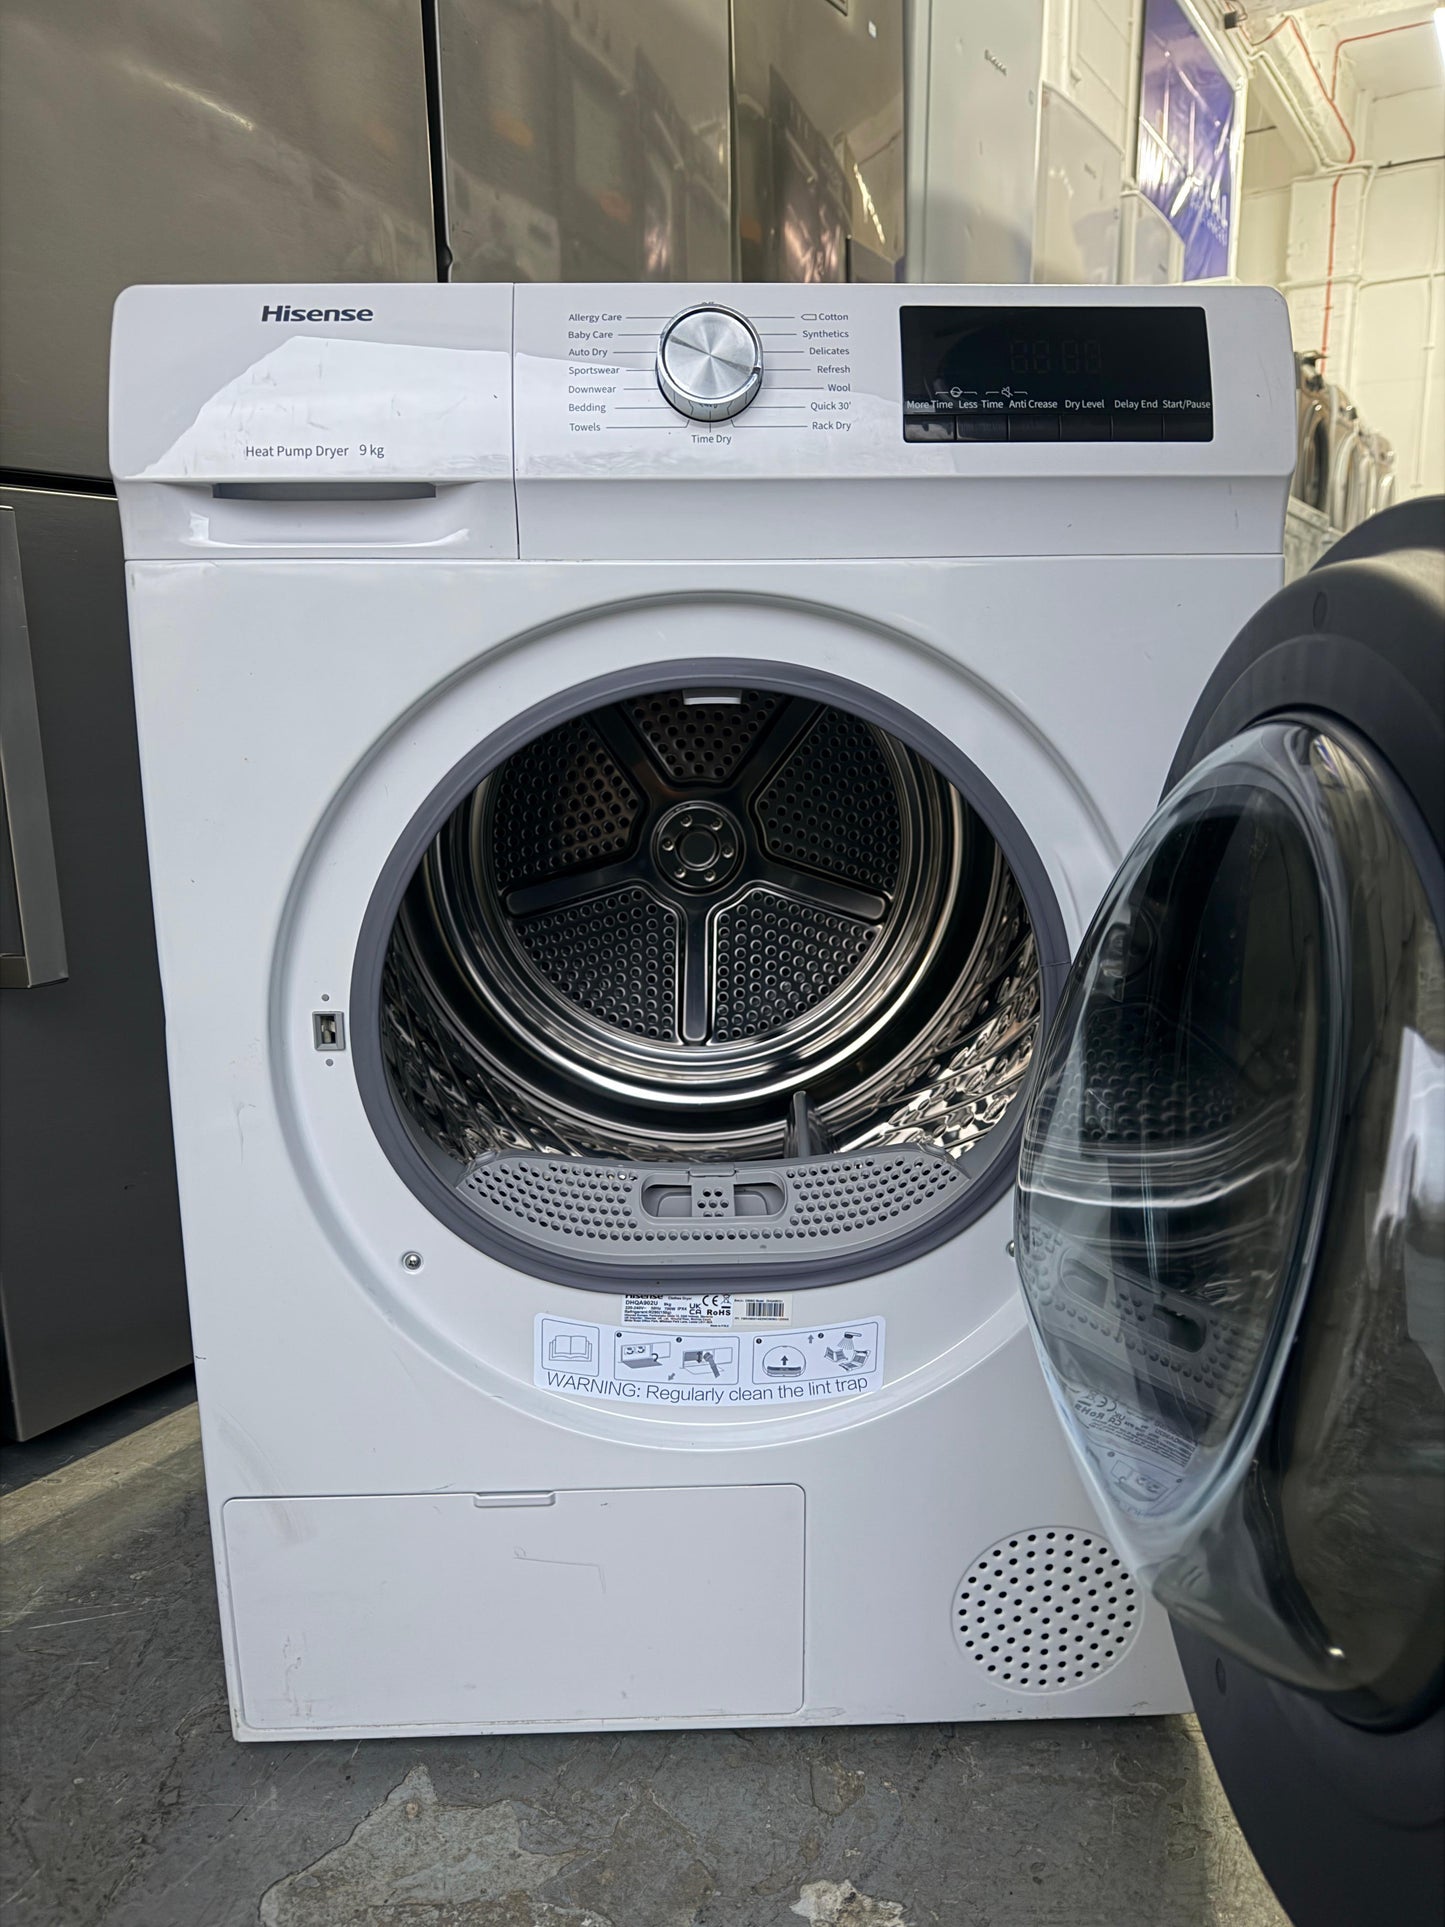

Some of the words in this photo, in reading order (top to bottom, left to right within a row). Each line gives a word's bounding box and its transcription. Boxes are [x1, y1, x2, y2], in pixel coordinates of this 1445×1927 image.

[261, 305, 374, 322] Hisense
[568, 313, 600, 324] Allergy
[601, 313, 623, 322] Care
[818, 312, 849, 321] Cotton
[567, 330, 590, 341] Baby
[592, 330, 614, 339] Care
[802, 329, 850, 340] Synthetics
[568, 348, 590, 357] Auto
[591, 347, 608, 359] Dry
[809, 346, 850, 356] Delicates
[568, 366, 620, 377] Sportswear
[817, 364, 851, 374] Refresh
[568, 385, 617, 394] Downwear
[827, 383, 851, 392] Wool
[568, 402, 607, 414] Bedding
[810, 401, 837, 412] Quick
[906, 400, 930, 409] More
[929, 399, 954, 410] Time
[958, 400, 978, 409] Less
[980, 399, 1004, 409] Time
[1008, 399, 1027, 409] Anti
[1028, 399, 1058, 409] Crease
[1064, 399, 1081, 411] Dry
[1081, 399, 1105, 409] Level
[1114, 399, 1140, 411] Delay
[1140, 399, 1158, 409] End
[1162, 399, 1211, 410] Start/Pause
[569, 422, 601, 432] Towels
[812, 420, 834, 431] Rack
[835, 421, 852, 432] Dry
[691, 434, 715, 444] Time
[716, 434, 732, 446] Dry
[245, 445, 275, 457] Heat
[276, 445, 313, 460] Pump
[315, 445, 350, 460] Dryer
[359, 443, 367, 456] 9
[369, 443, 385, 459] kg
[547, 1371, 641, 1399] WARNING:
[646, 1385, 725, 1405] Regularly
[729, 1388, 774, 1402] clean
[777, 1385, 804, 1399] the
[809, 1381, 832, 1396] lint
[835, 1377, 868, 1395] trap
